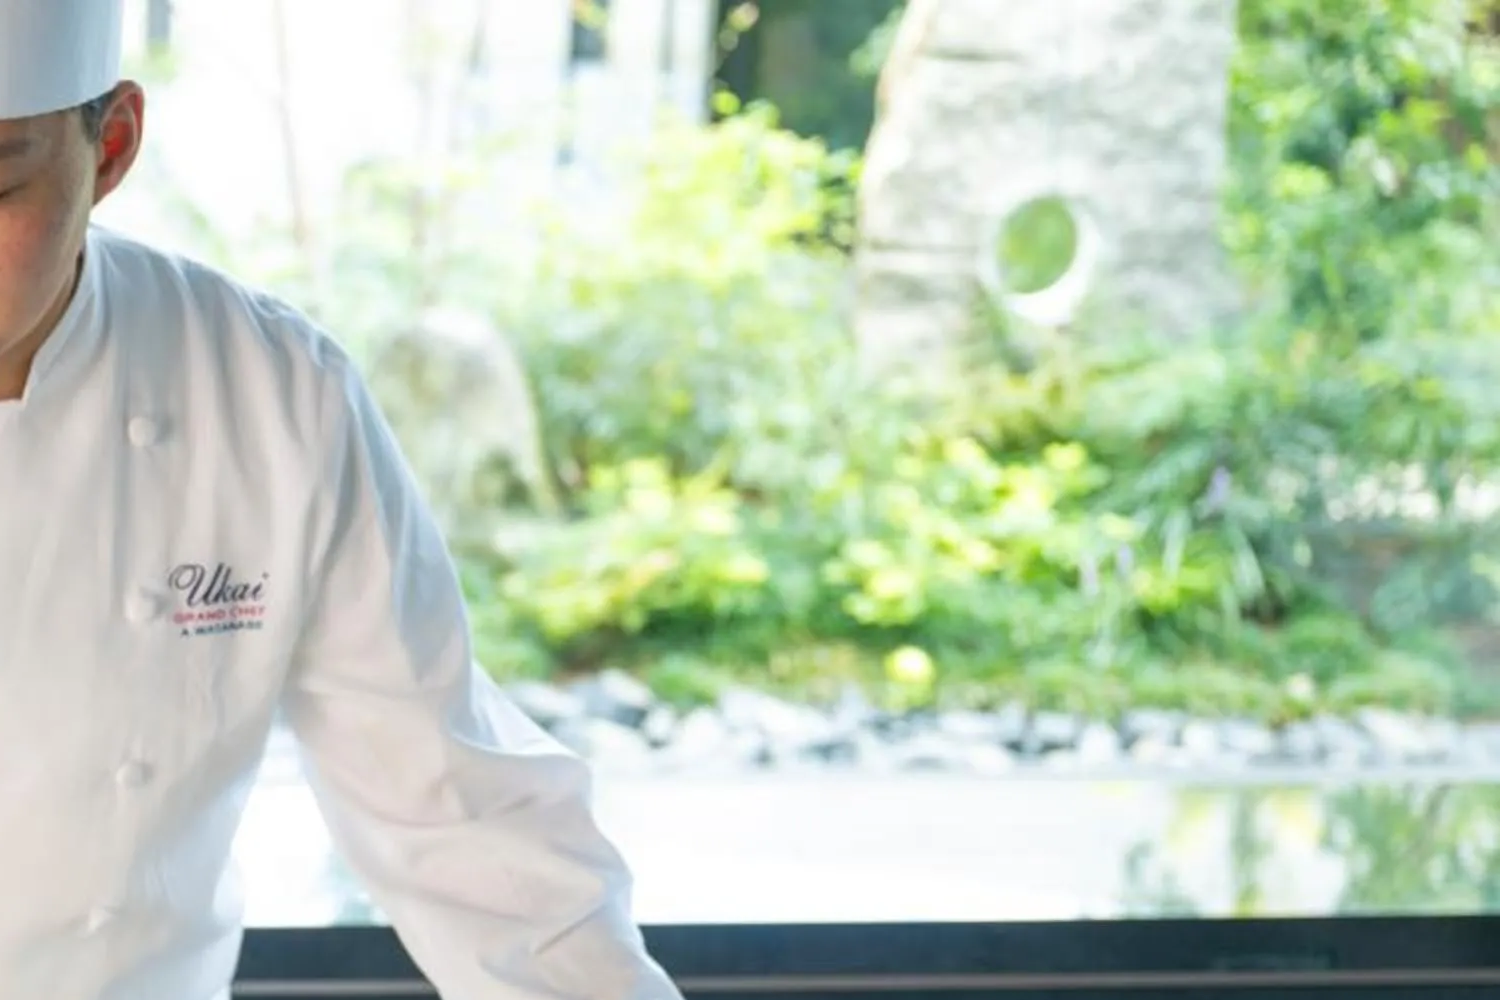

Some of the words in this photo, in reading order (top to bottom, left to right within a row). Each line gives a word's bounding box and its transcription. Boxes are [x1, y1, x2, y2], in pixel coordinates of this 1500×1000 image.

[168, 562, 269, 607] Ukai
[173, 608, 227, 624] GRAND
[229, 605, 265, 620] CHEF
